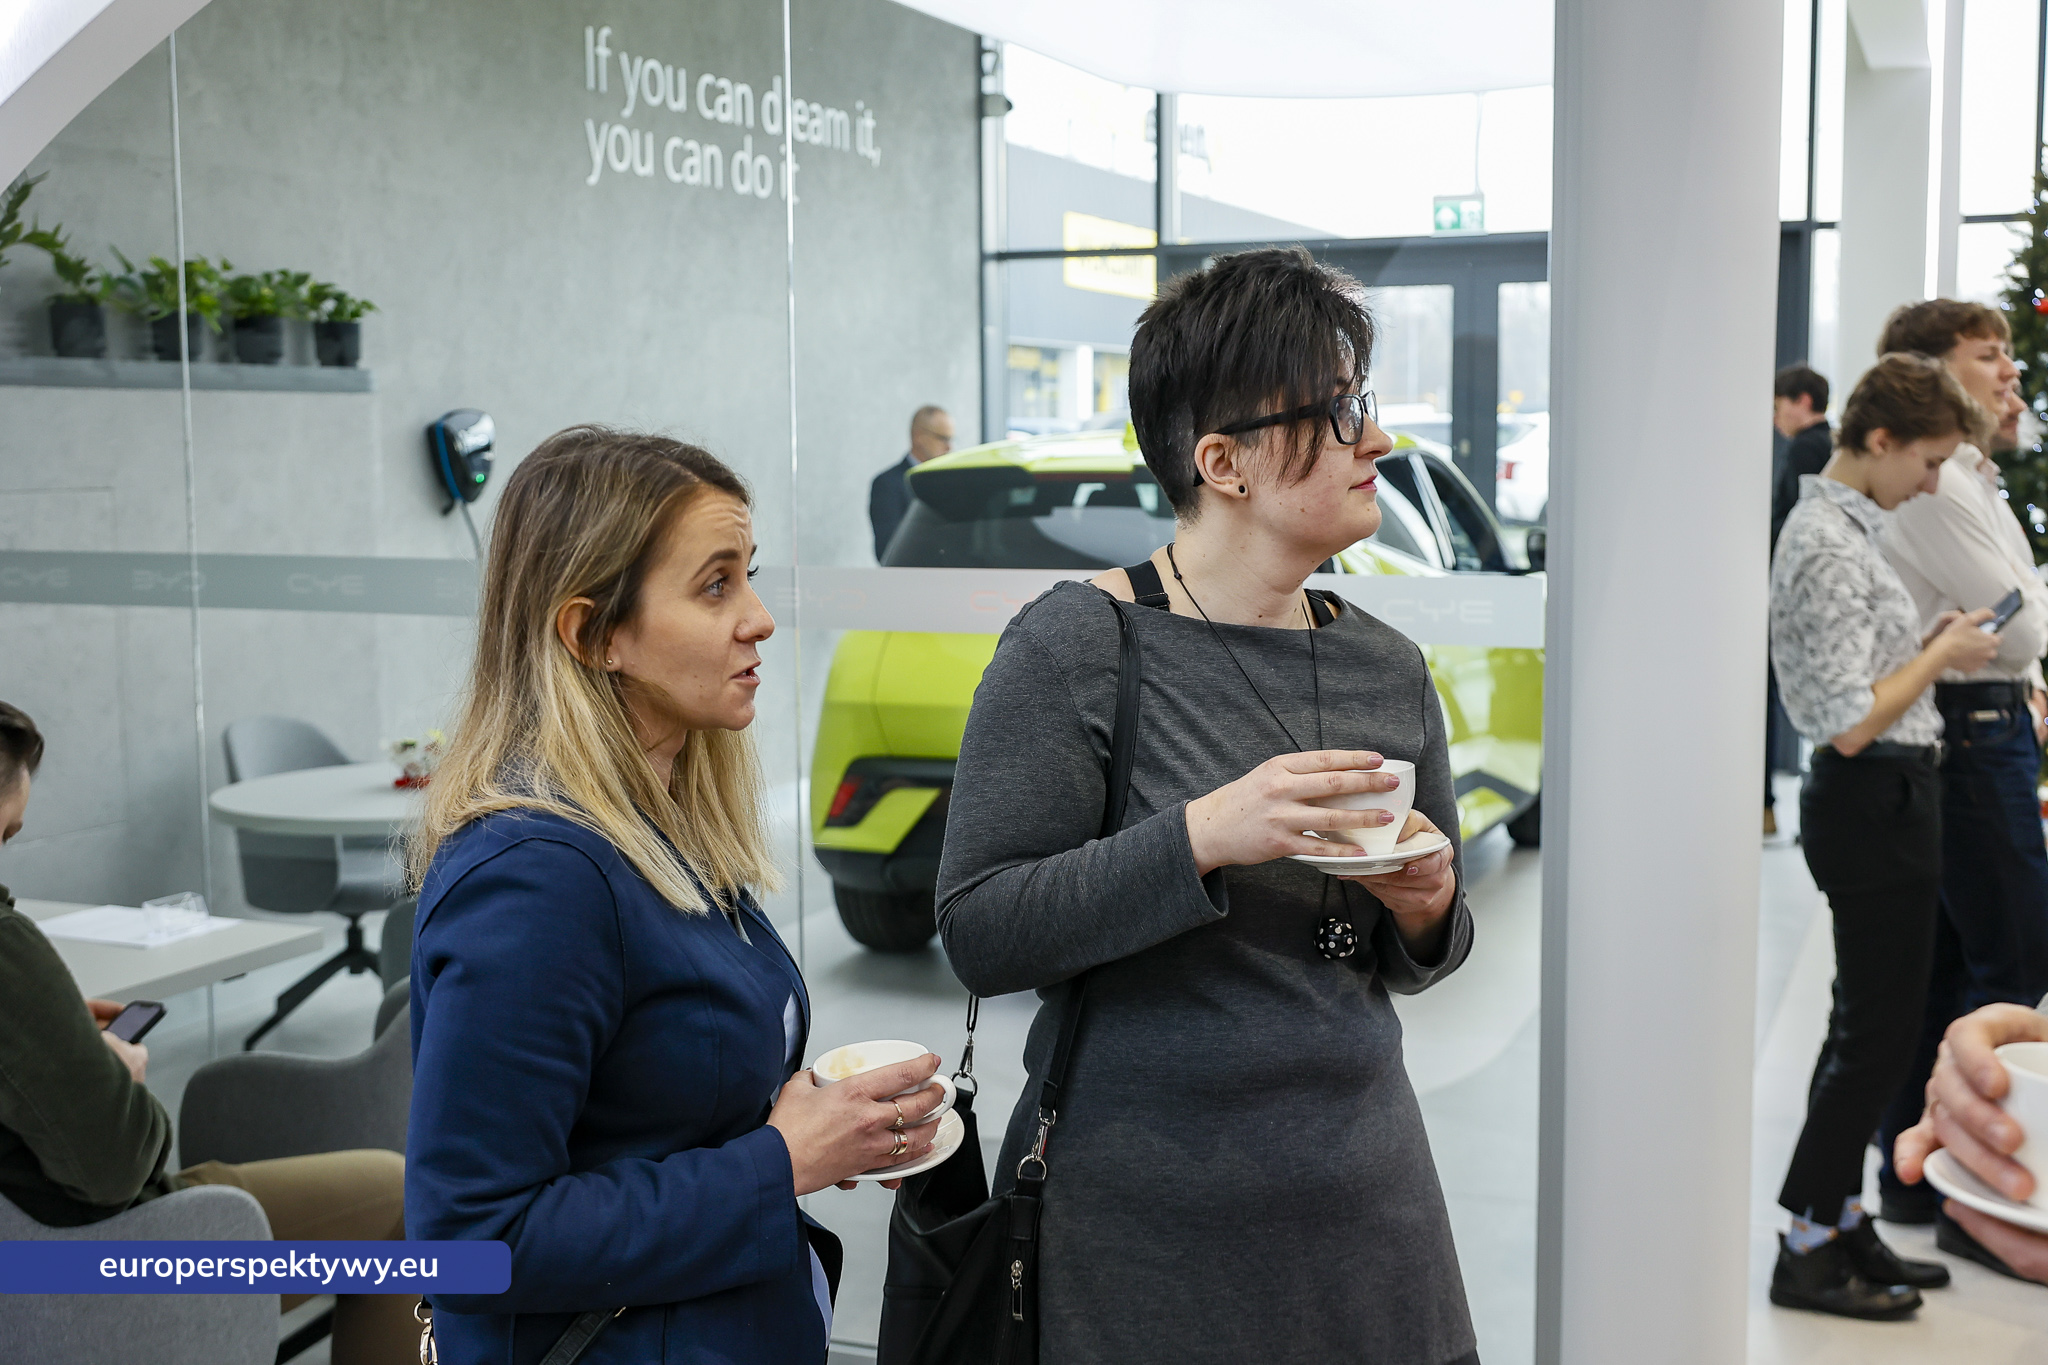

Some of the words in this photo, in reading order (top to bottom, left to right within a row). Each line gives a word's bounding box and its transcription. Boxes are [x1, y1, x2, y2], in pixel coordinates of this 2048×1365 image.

[584, 25, 612, 93] If
[618, 51, 687, 118] you
[696, 73, 755, 129] can
[761, 75, 850, 152] deam
[855, 100, 881, 168] it,
[584, 118, 654, 186] you
[663, 136, 724, 190] can
[731, 134, 774, 199] do
